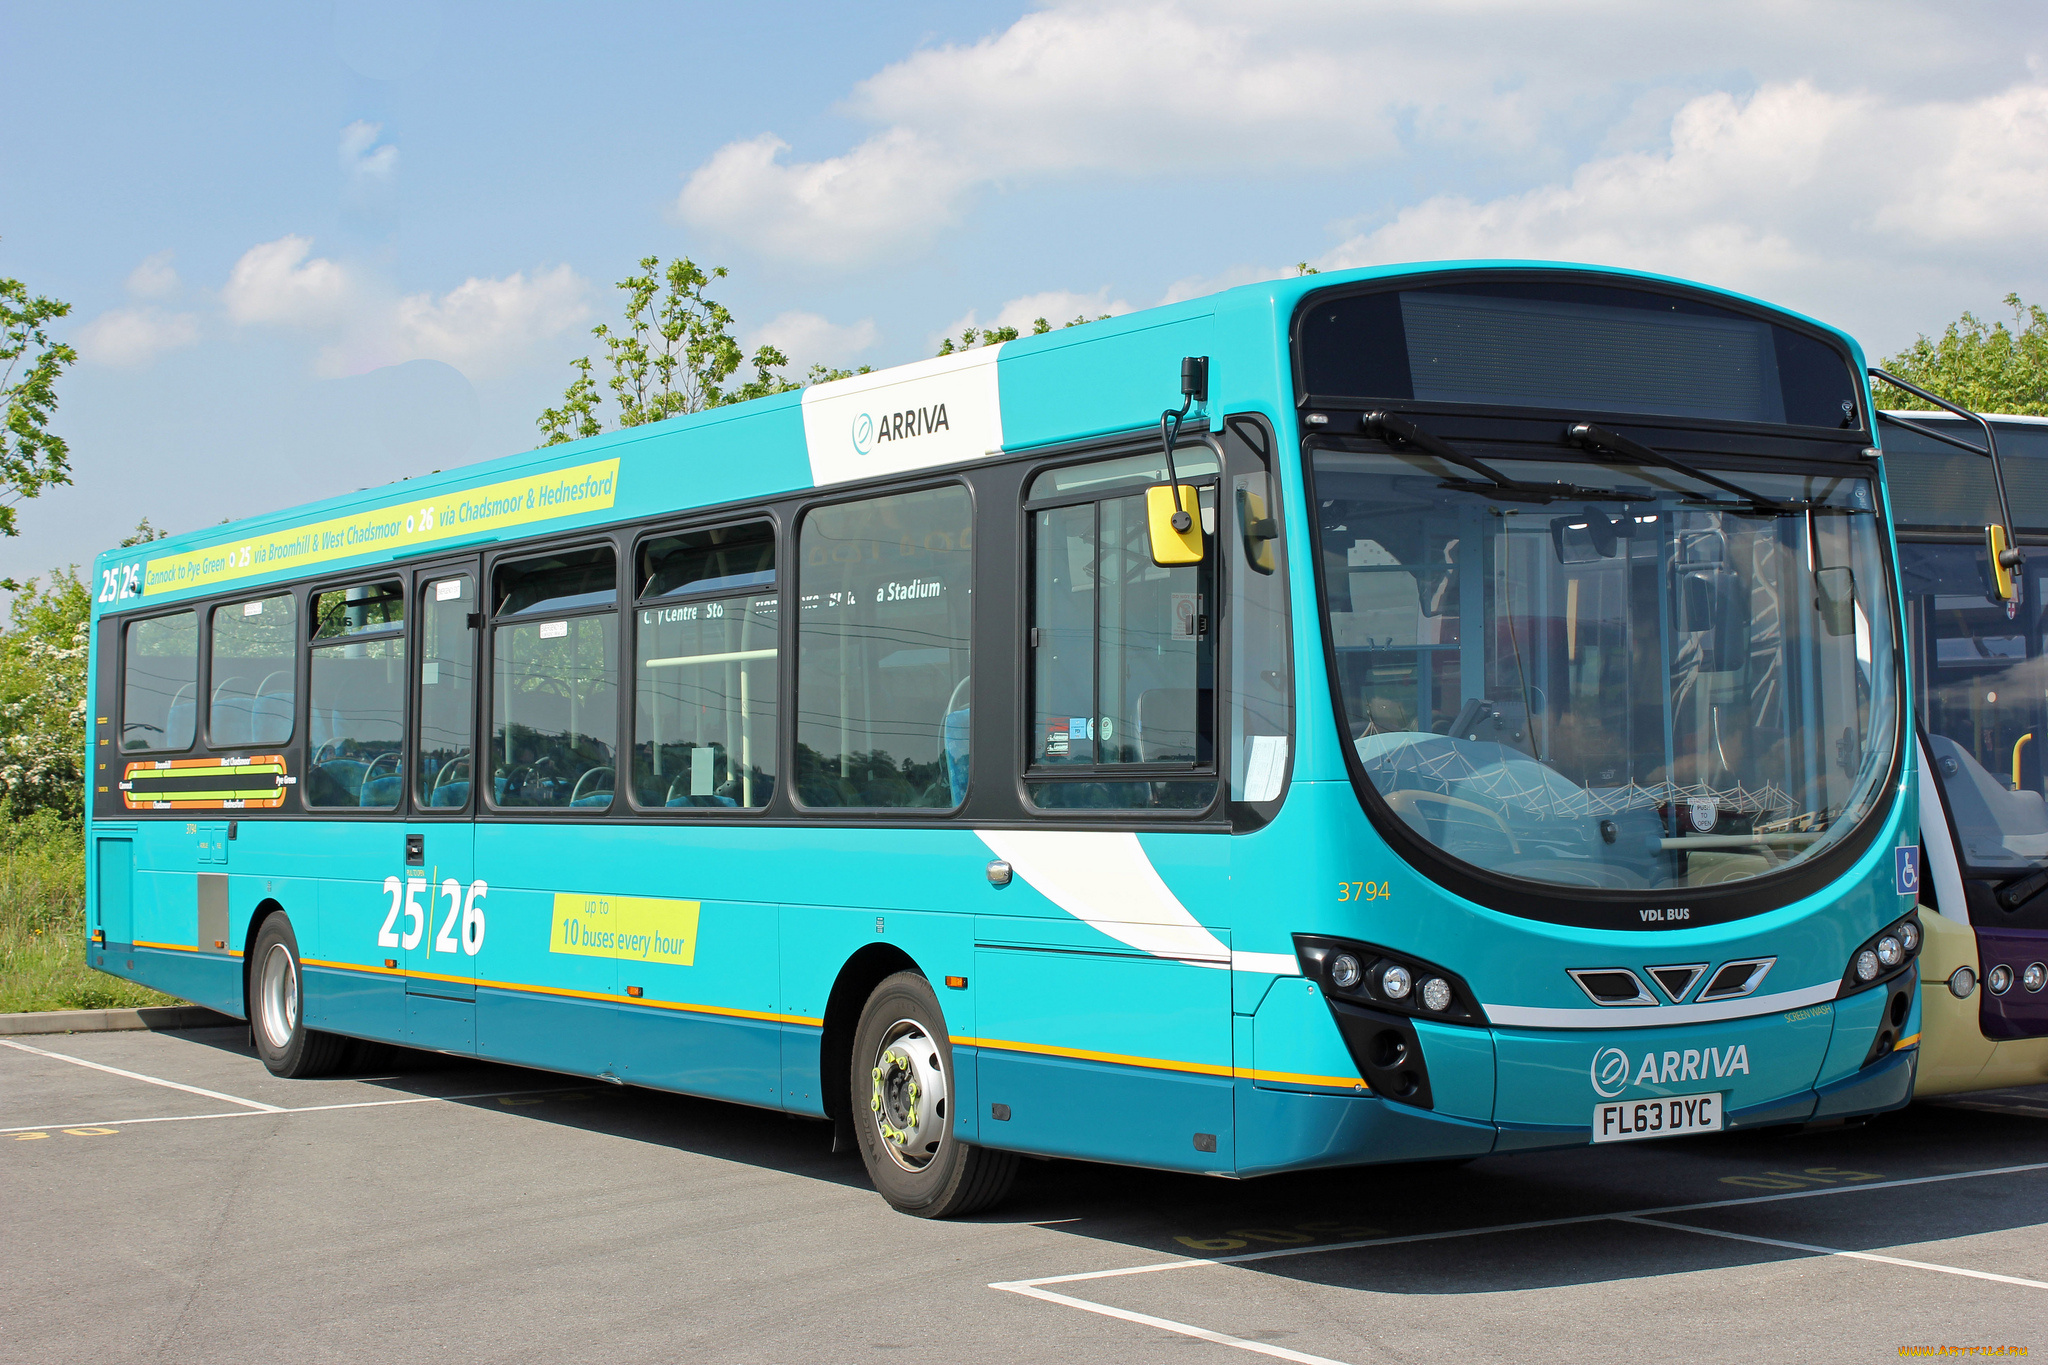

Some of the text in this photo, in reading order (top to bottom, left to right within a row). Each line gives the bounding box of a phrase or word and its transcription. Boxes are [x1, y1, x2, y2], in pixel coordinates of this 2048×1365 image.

[877, 403, 950, 444] ARRIVA
[146, 471, 614, 586] Cannock to Pye Green 25 via Broomhill & West Chadsmoor 26 via Chadsmoor & Hednesford
[98, 568, 119, 603] 25
[887, 579, 941, 602] Stadium
[665, 606, 698, 623] Centre
[584, 898, 610, 918] up to
[1337, 881, 1392, 902] 3794
[377, 875, 489, 956] 25 26
[1639, 908, 1690, 922] VDL BUS
[563, 918, 685, 958] 10 buses every hour
[1784, 1004, 1832, 1023] SCREEN WASH
[1633, 1044, 1750, 1086] ARRIVA
[1603, 1098, 1712, 1136] FL63 DYC
